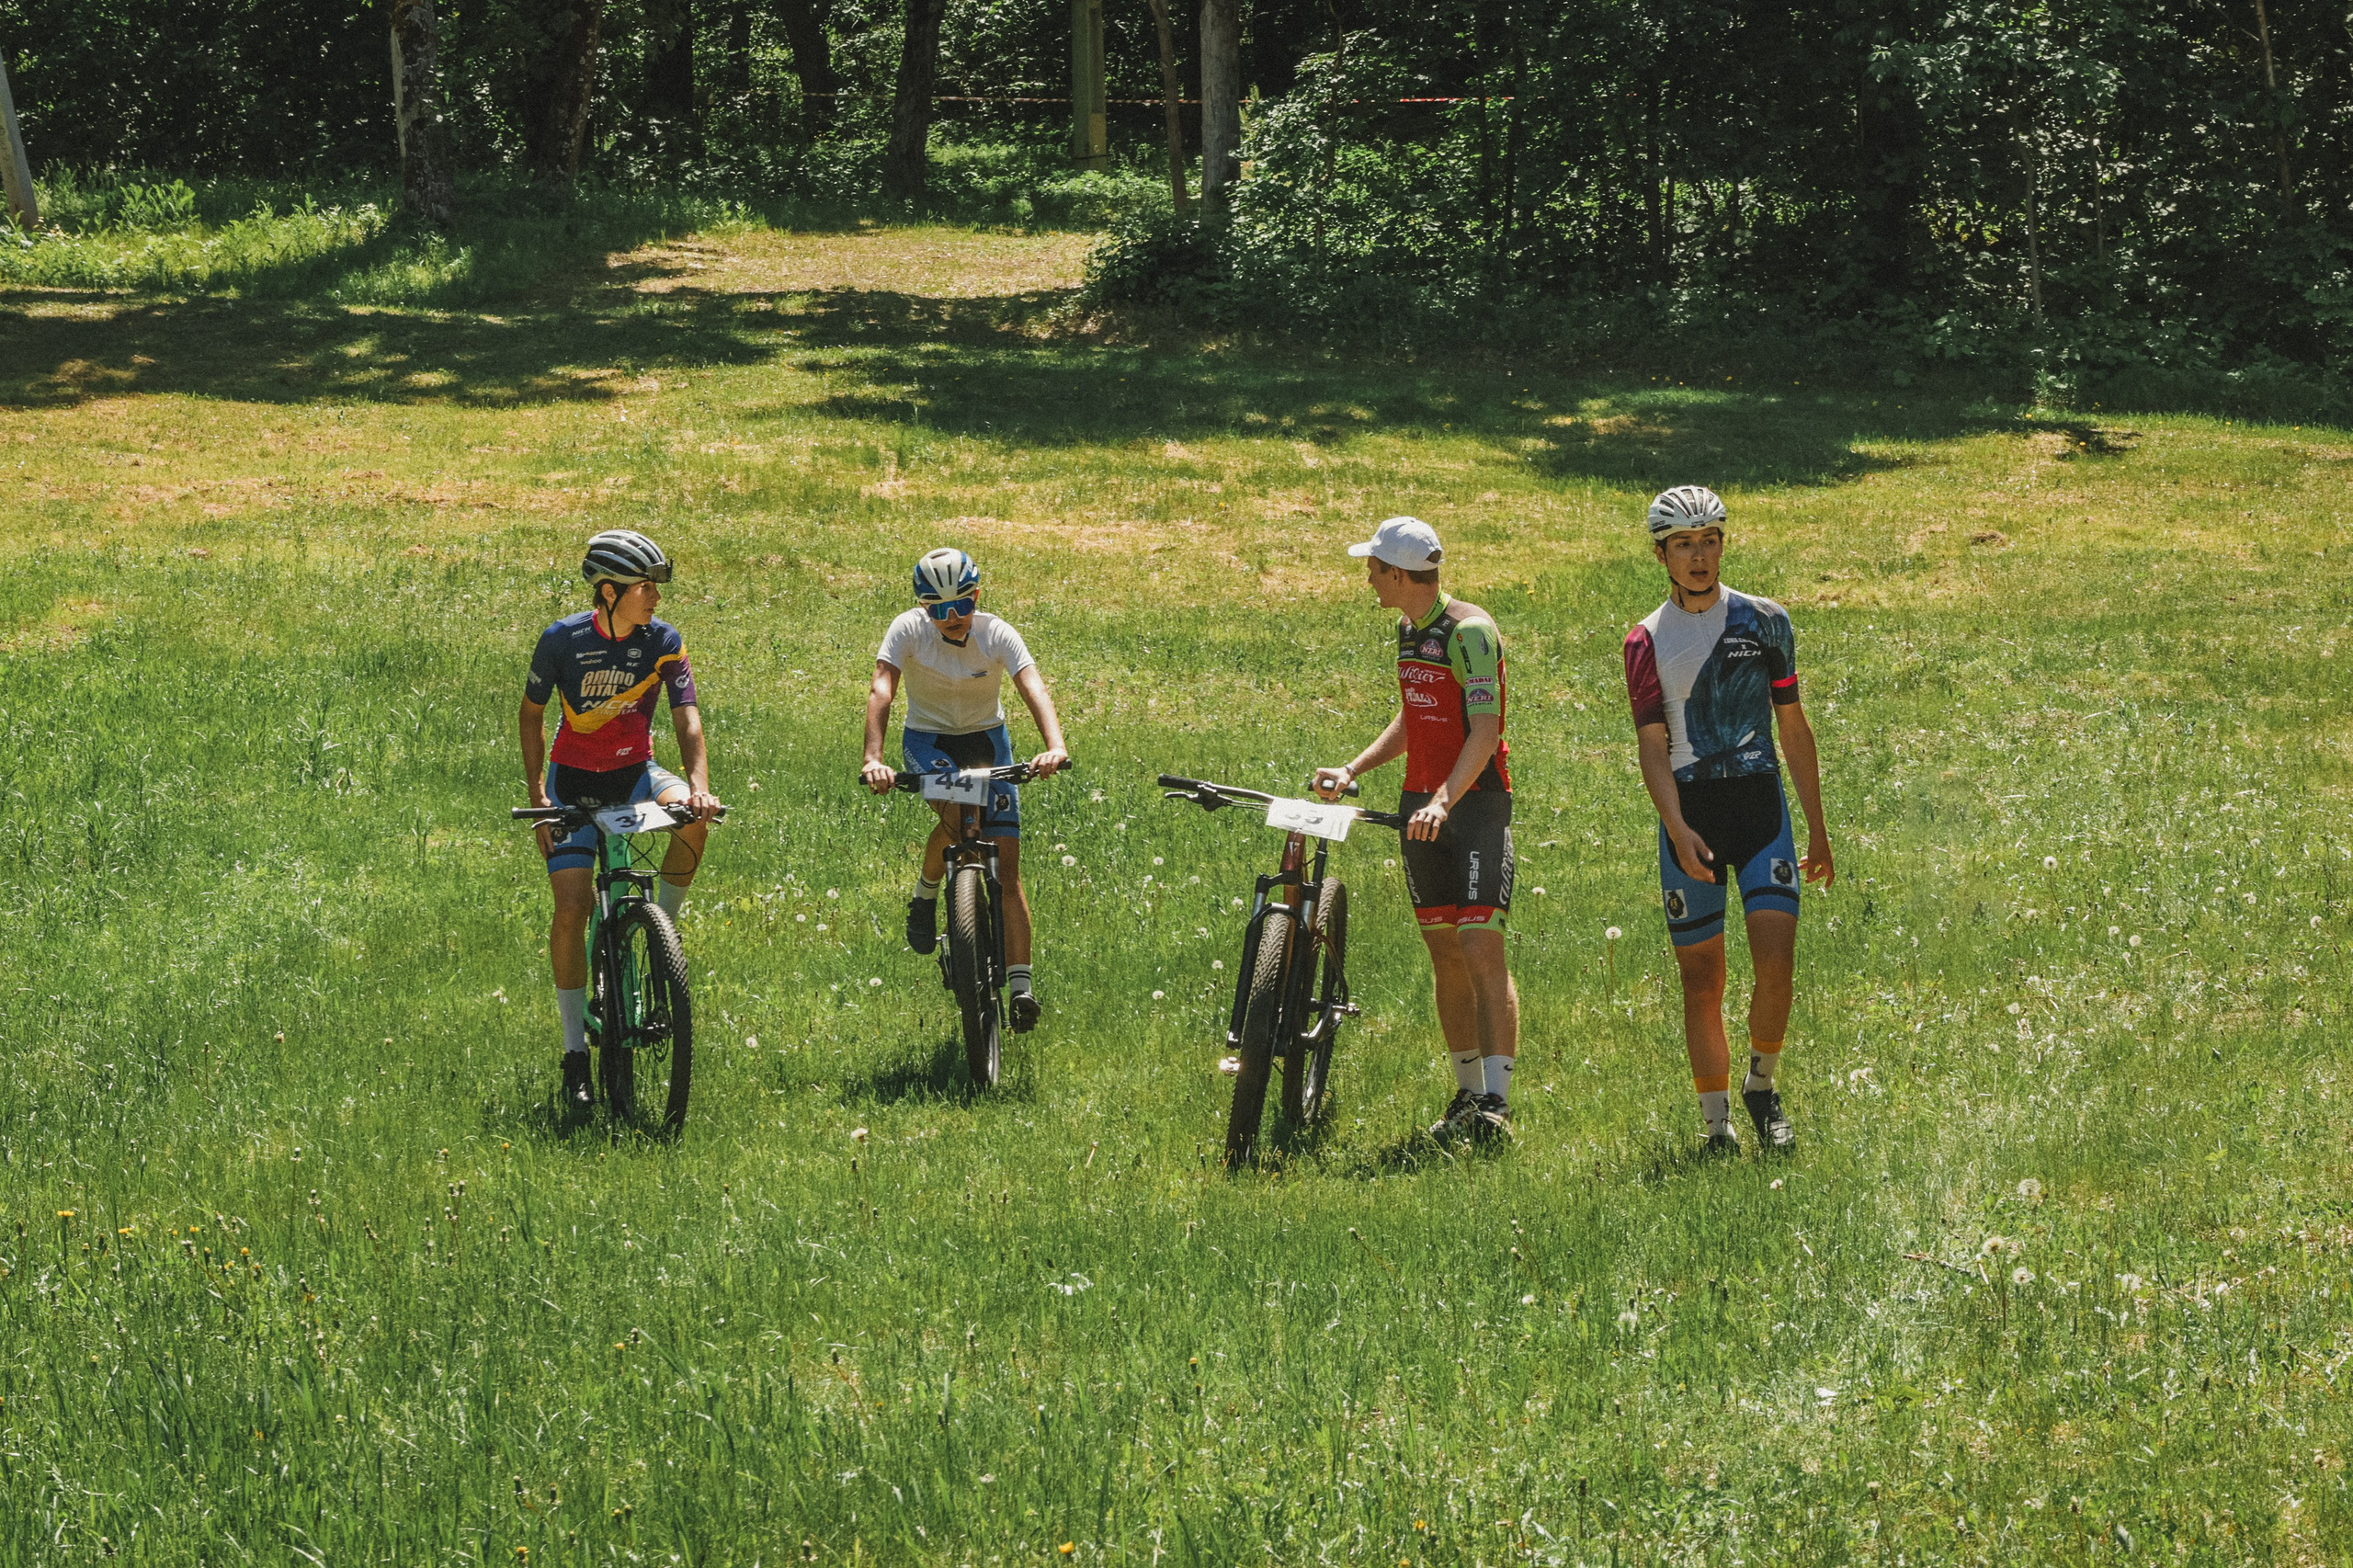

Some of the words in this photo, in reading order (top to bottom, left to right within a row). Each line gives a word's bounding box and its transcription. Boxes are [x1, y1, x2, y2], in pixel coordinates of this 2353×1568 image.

[1422, 646, 1441, 655] NERI
[1727, 650, 1762, 658] NICH
[581, 665, 635, 687] amino
[581, 699, 638, 710] NICH
[1466, 695, 1492, 704] NERI
[936, 772, 973, 792] 44
[1468, 850, 1480, 901] URSUS
